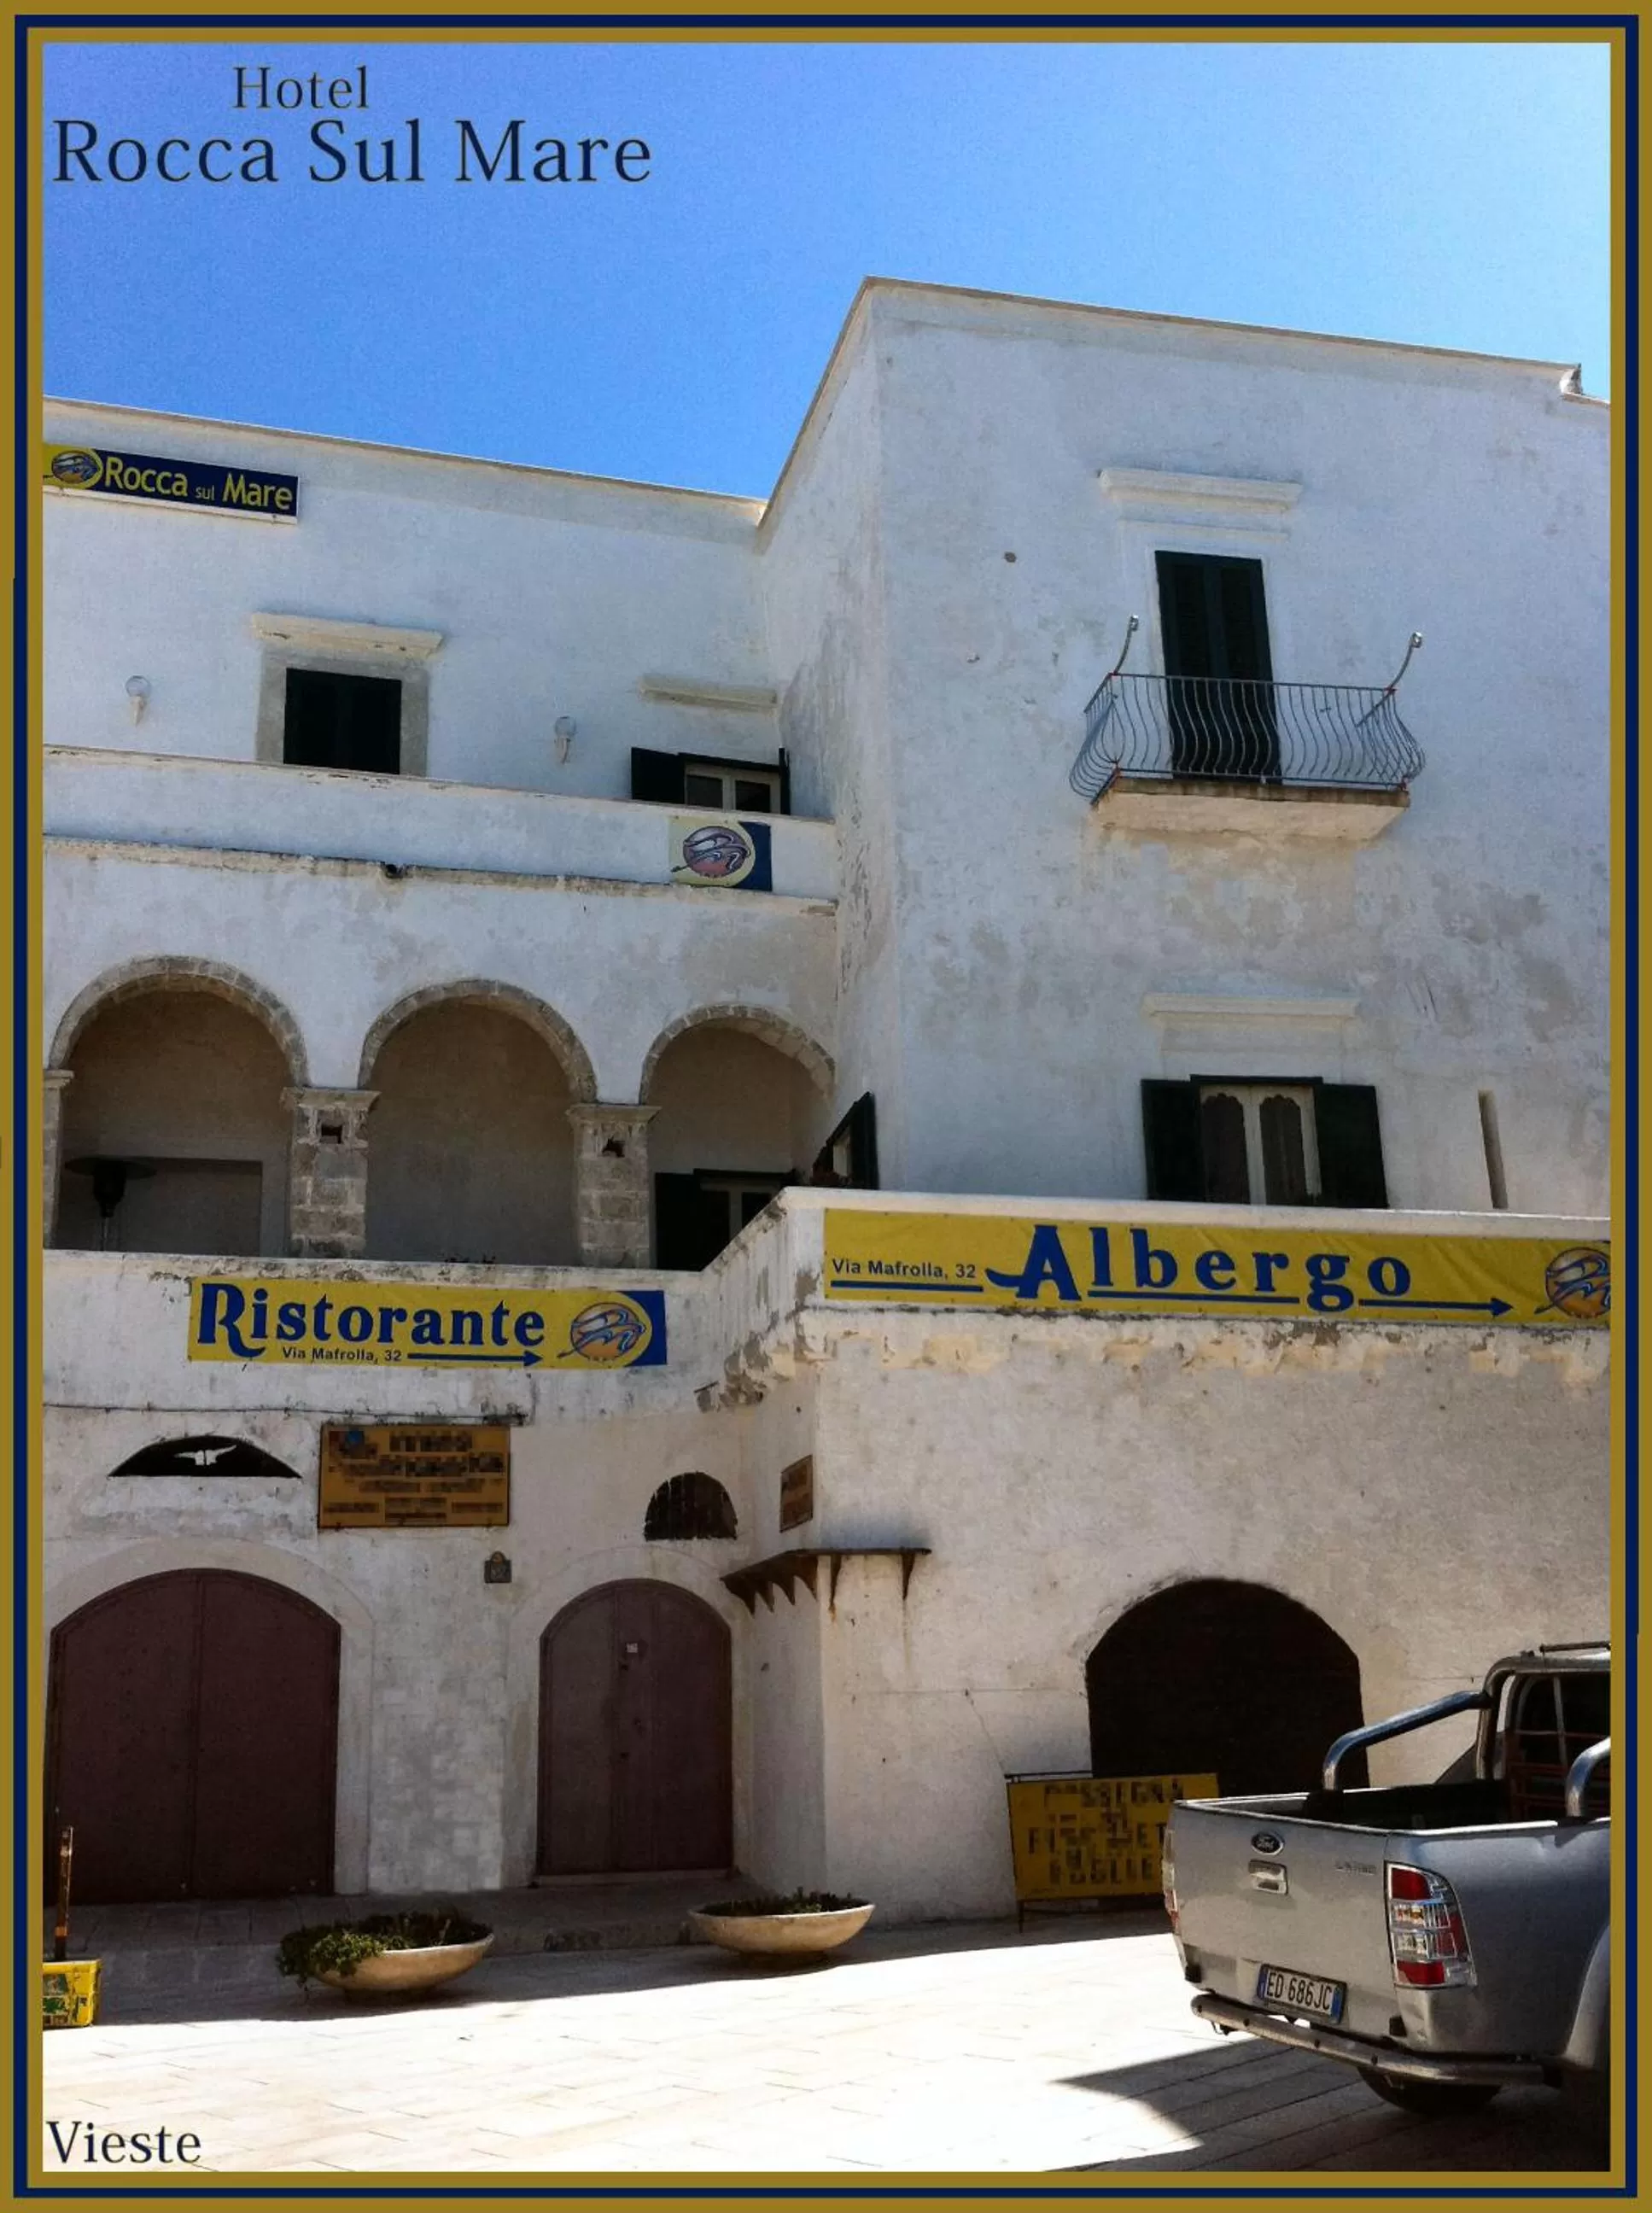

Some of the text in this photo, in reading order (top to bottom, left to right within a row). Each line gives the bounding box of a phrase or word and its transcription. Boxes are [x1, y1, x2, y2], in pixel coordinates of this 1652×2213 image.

[104, 457, 293, 510] Rocca sul Mare
[832, 1258, 976, 1279] Via Mafrolla, 32
[985, 1224, 1411, 1312] Albergo
[197, 1282, 544, 1358] Ristorante
[283, 1346, 401, 1364] Via Mafrolla, 32
[1267, 1971, 1333, 2010] ED 686JC
